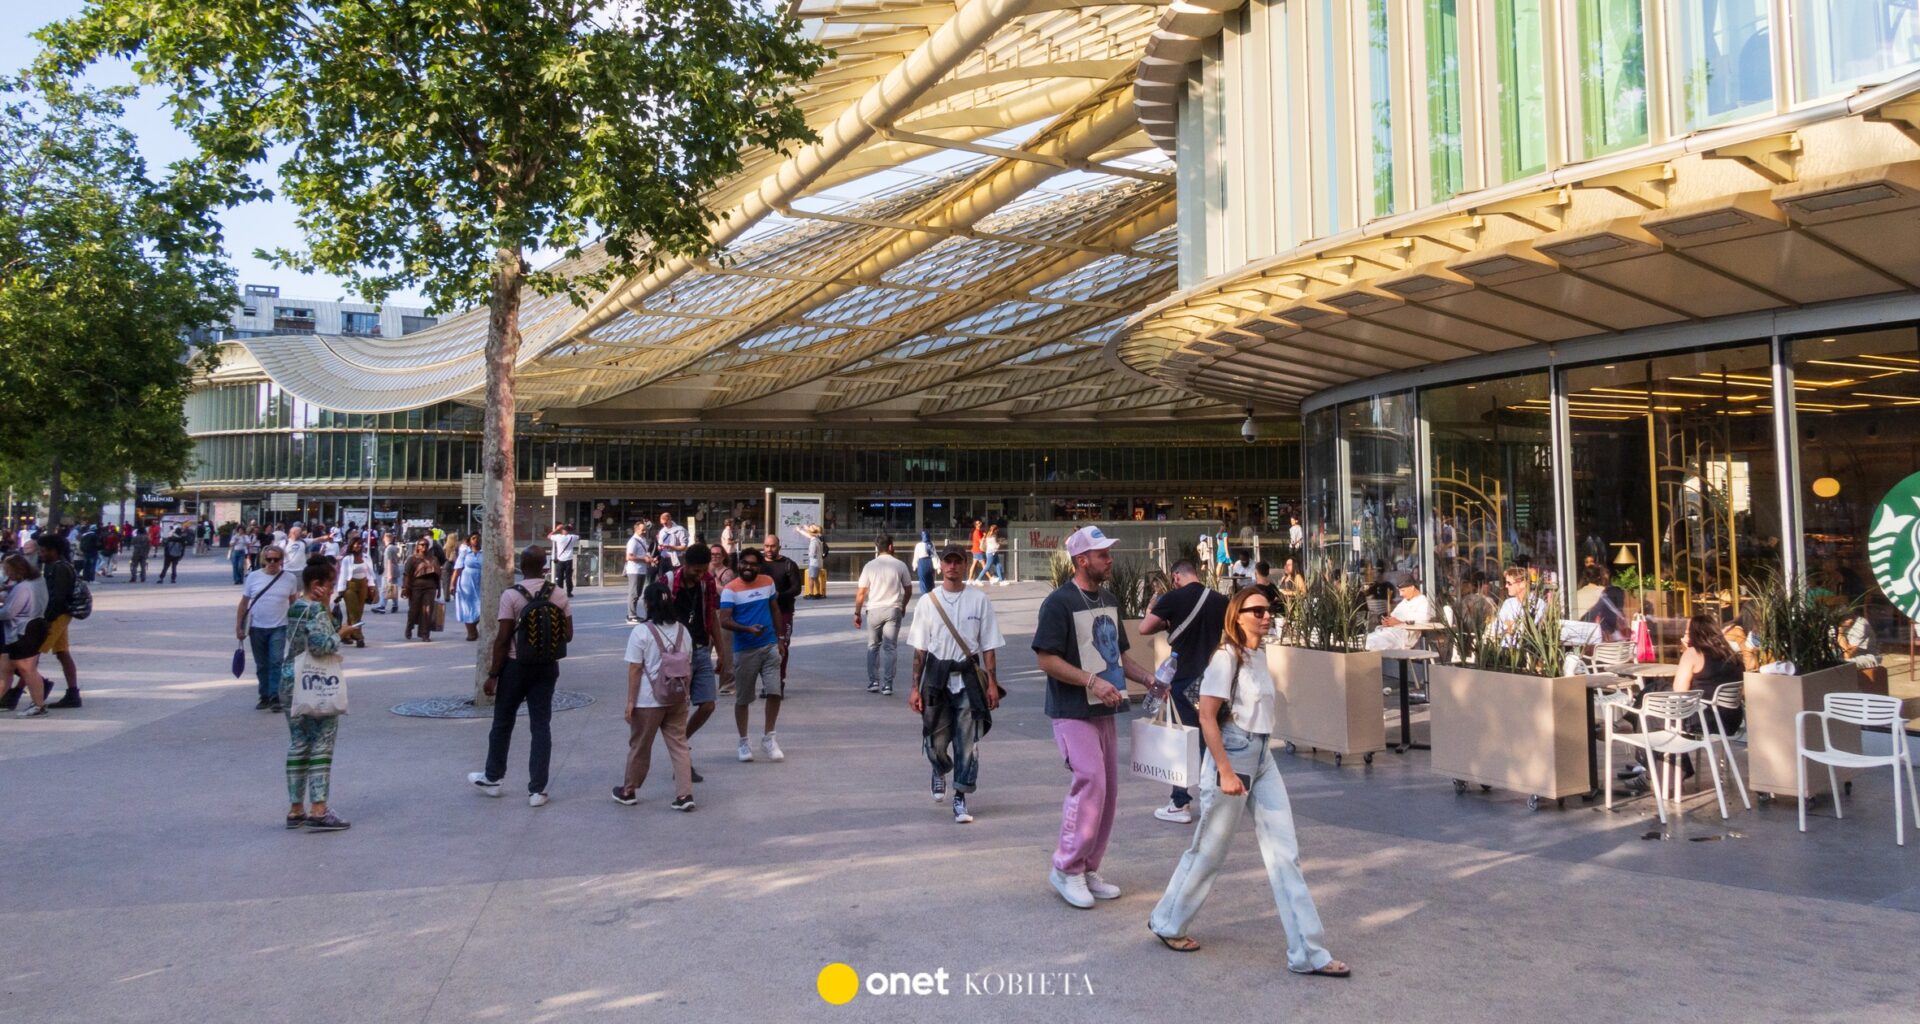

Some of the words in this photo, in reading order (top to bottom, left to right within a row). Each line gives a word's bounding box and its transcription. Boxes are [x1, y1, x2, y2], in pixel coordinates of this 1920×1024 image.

[142, 494, 174, 502] Maison
[1029, 531, 1060, 549] Westfield
[1133, 761, 1184, 781] BOMPARD
